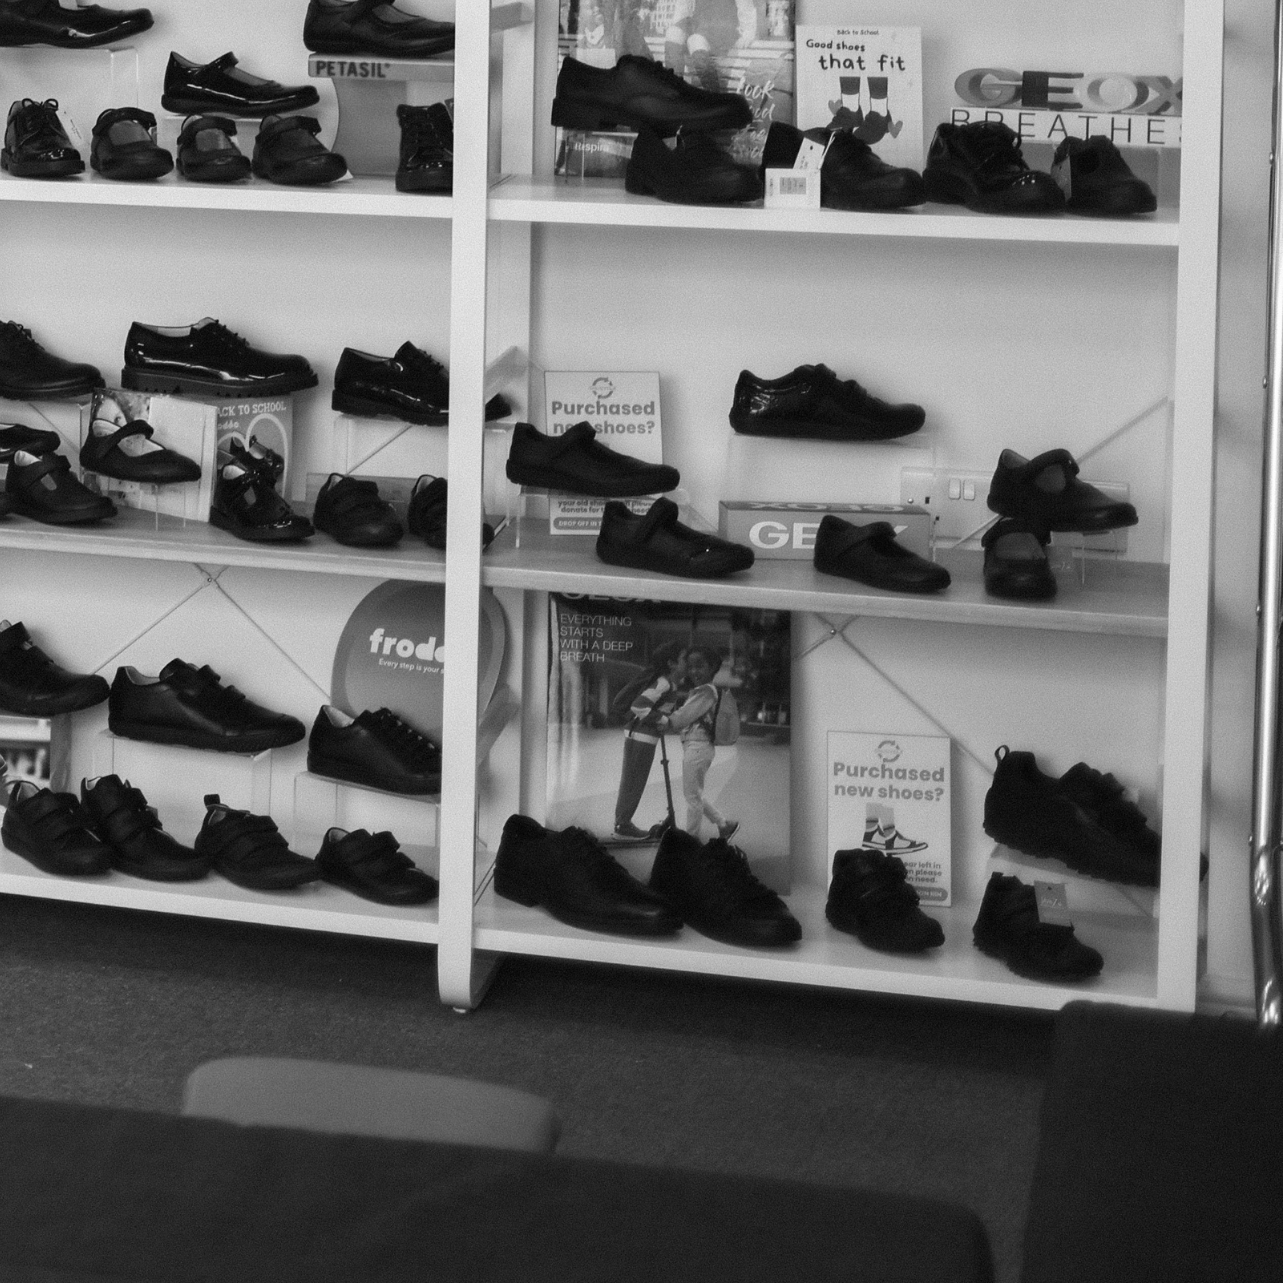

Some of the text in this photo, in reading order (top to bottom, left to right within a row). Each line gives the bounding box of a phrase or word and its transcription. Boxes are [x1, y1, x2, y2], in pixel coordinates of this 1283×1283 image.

[805, 39, 865, 52] Good shoes
[316, 60, 386, 78] PETASIL
[818, 53, 906, 72] that fit
[954, 68, 1183, 115] GEOX
[952, 109, 1182, 145] BREATHE
[238, 404, 250, 415] TO
[252, 401, 287, 414] SCHOOL
[551, 400, 655, 416] Purchased
[594, 420, 655, 435] shoes?
[560, 614, 632, 626] EVERYTHING
[560, 626, 604, 638] STARTS
[560, 639, 633, 651] WITH A DEEP
[560, 651, 605, 662] BREATH
[379, 658, 440, 674] Every step is your
[833, 761, 945, 782] Purchased
[834, 783, 944, 802] new shoes?
